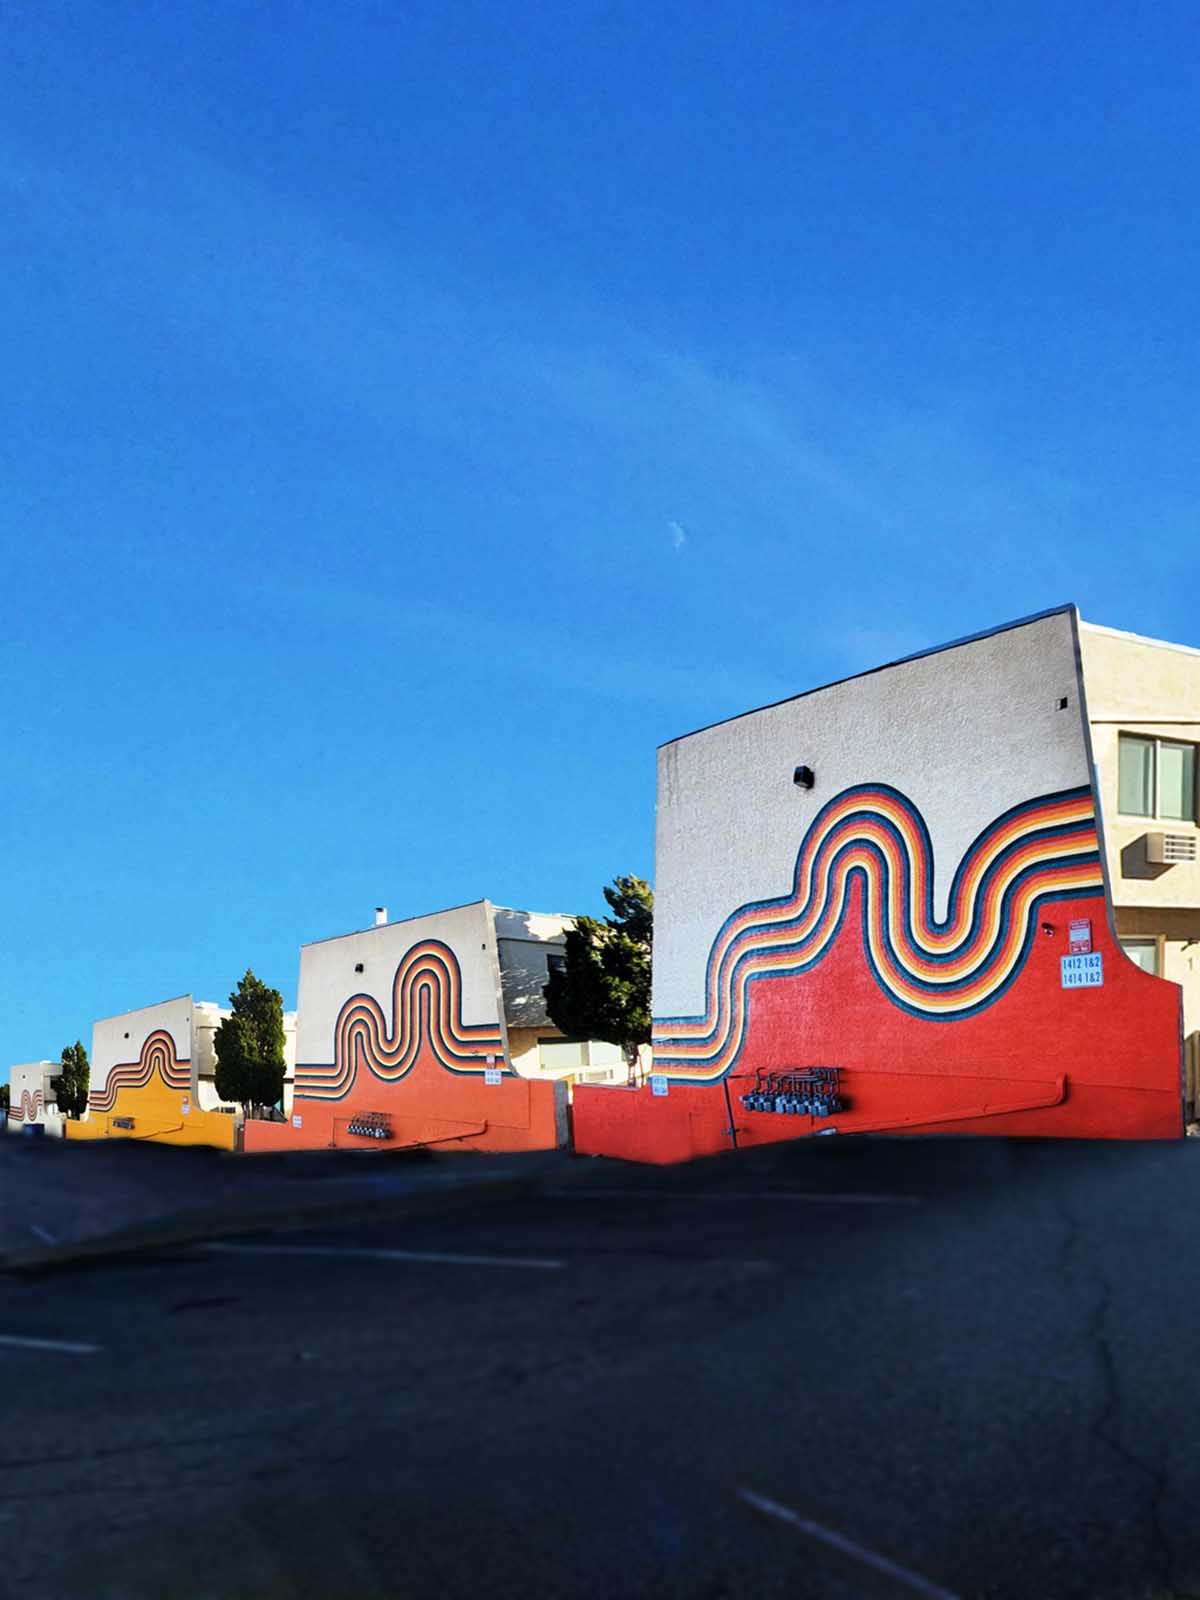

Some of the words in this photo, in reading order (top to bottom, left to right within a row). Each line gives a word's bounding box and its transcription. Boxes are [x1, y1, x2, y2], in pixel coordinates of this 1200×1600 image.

[1063, 957, 1082, 970] 1412
[1084, 955, 1100, 968] 1&2
[1063, 972, 1082, 985] 1414
[1085, 971, 1101, 984] 1&2
